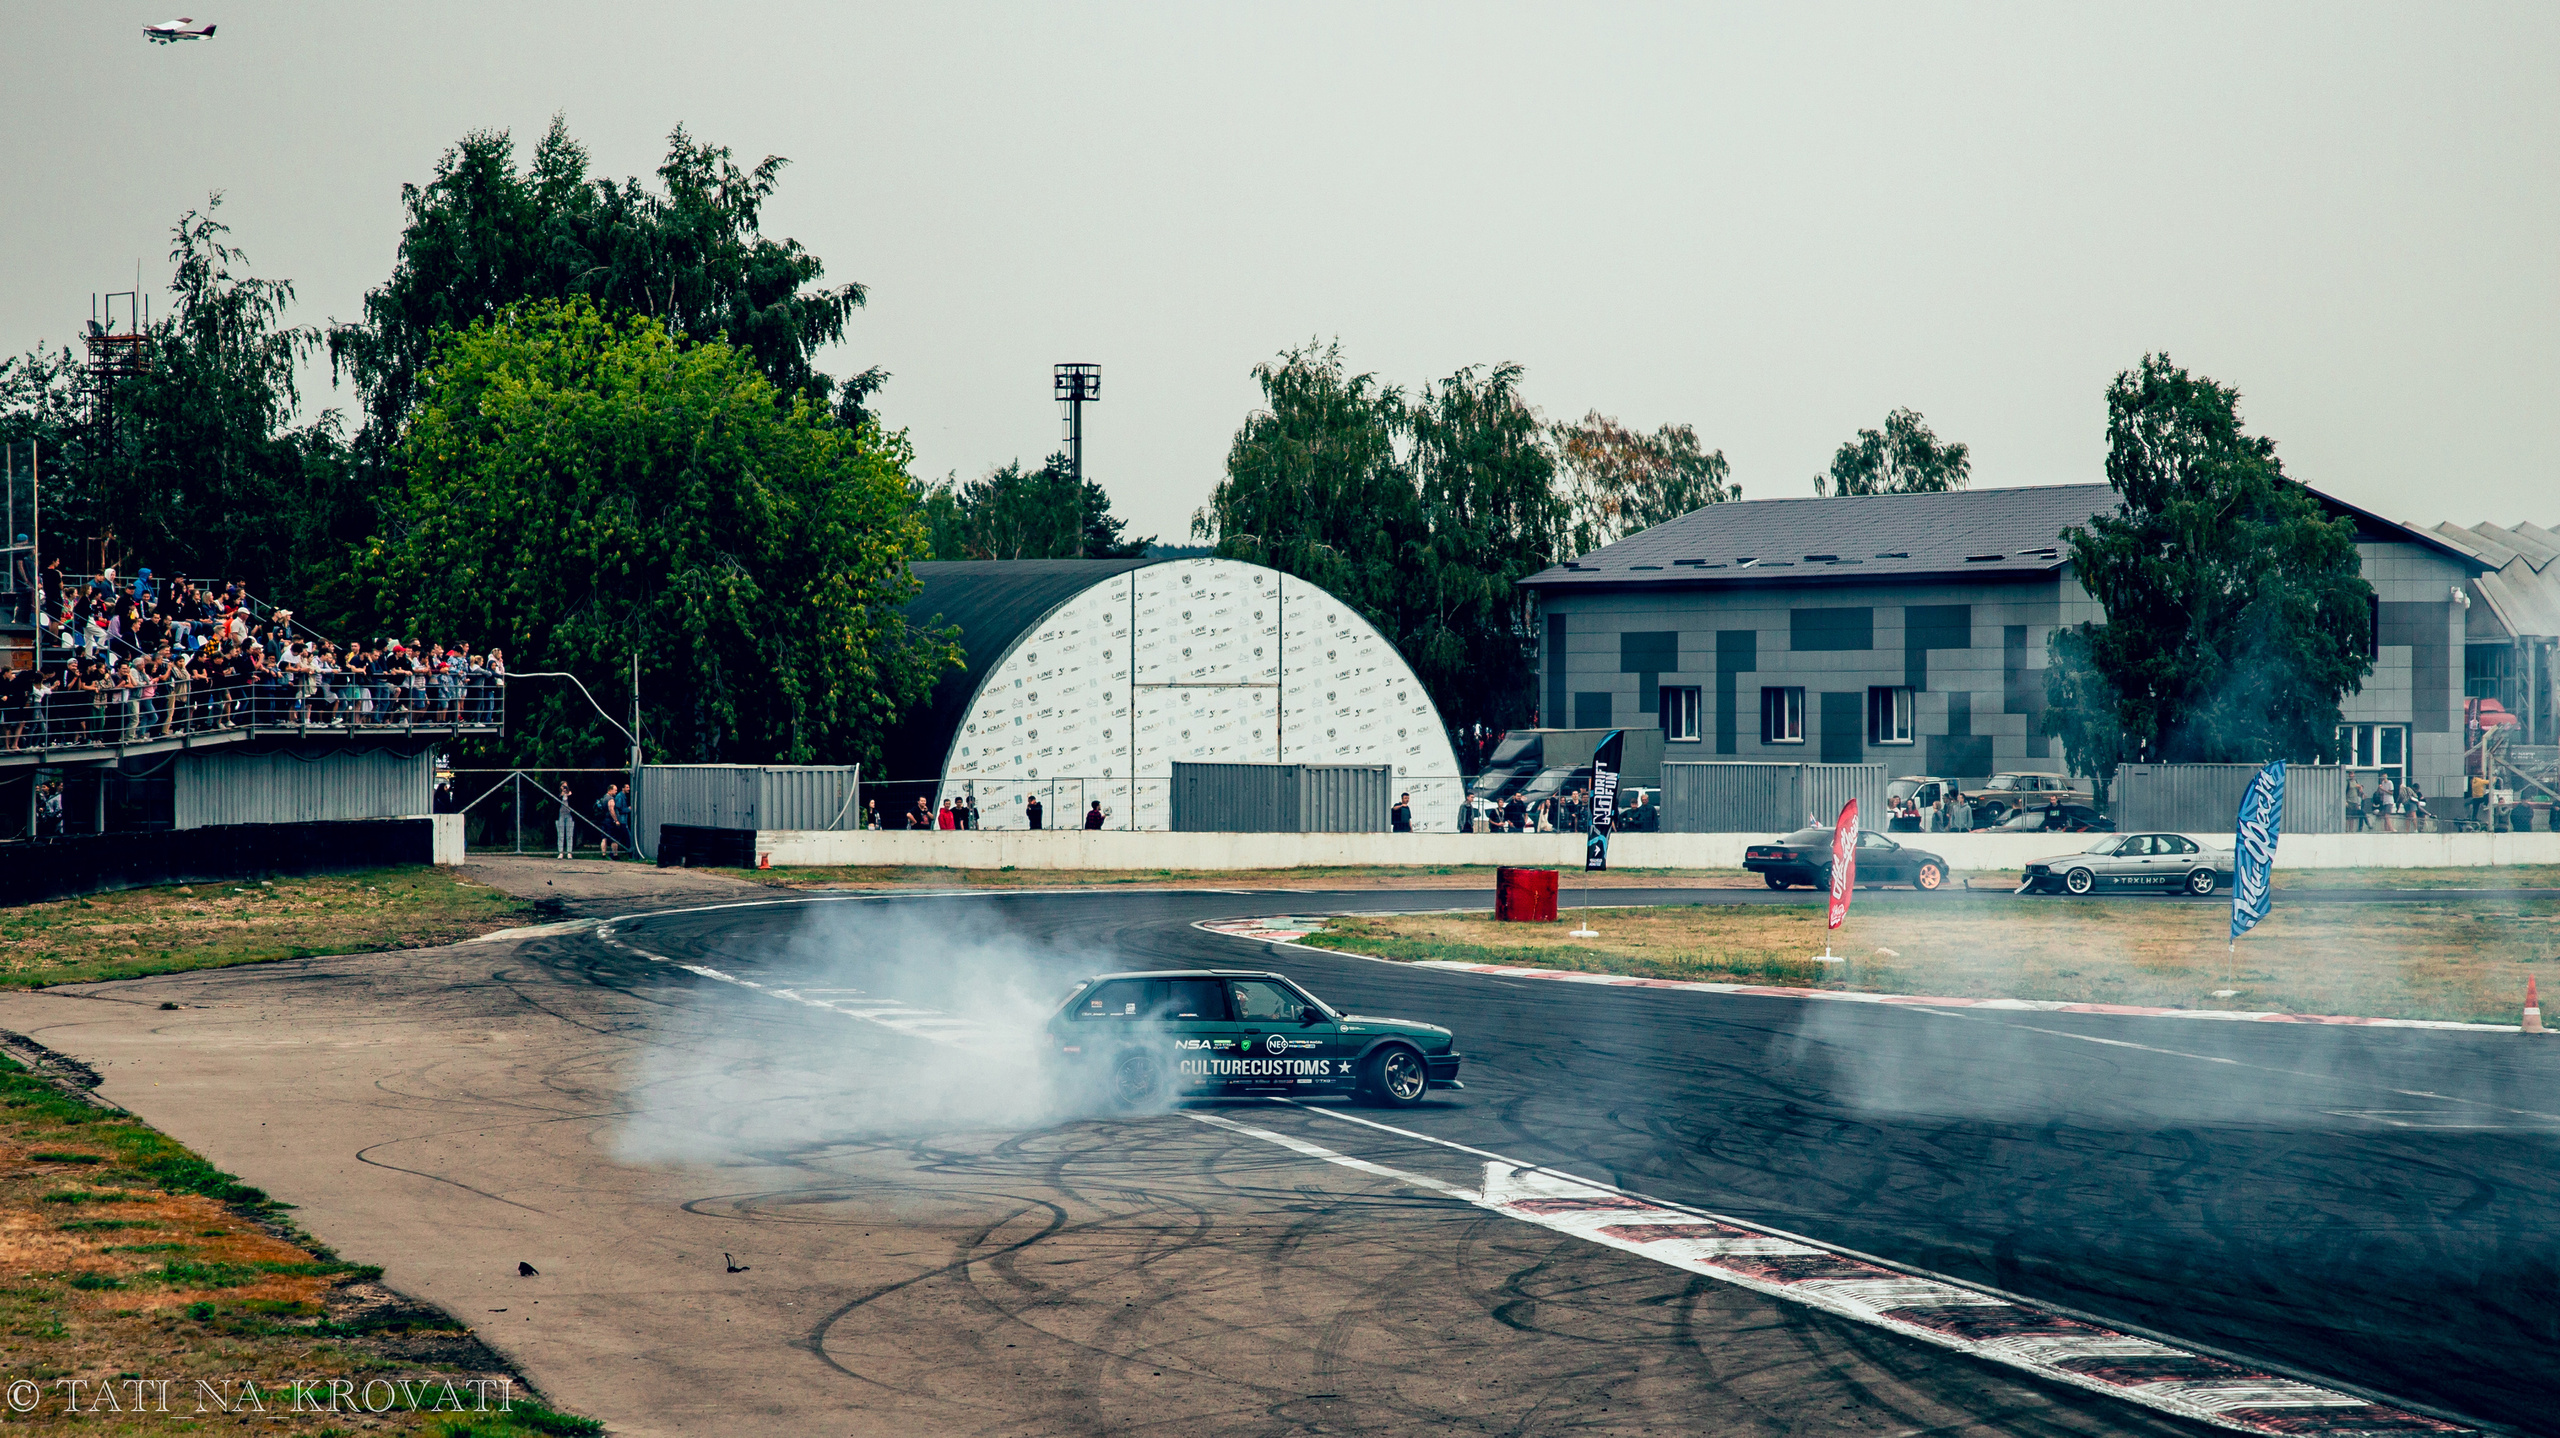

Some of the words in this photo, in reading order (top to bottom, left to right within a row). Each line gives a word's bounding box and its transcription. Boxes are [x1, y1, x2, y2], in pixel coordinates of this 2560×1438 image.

[1594, 760, 1608, 795] DRIFT
[1605, 772, 1619, 796] FUN
[1174, 1039, 1211, 1049] NSA
[1180, 1059, 1330, 1075] CULTURECUSTOMS
